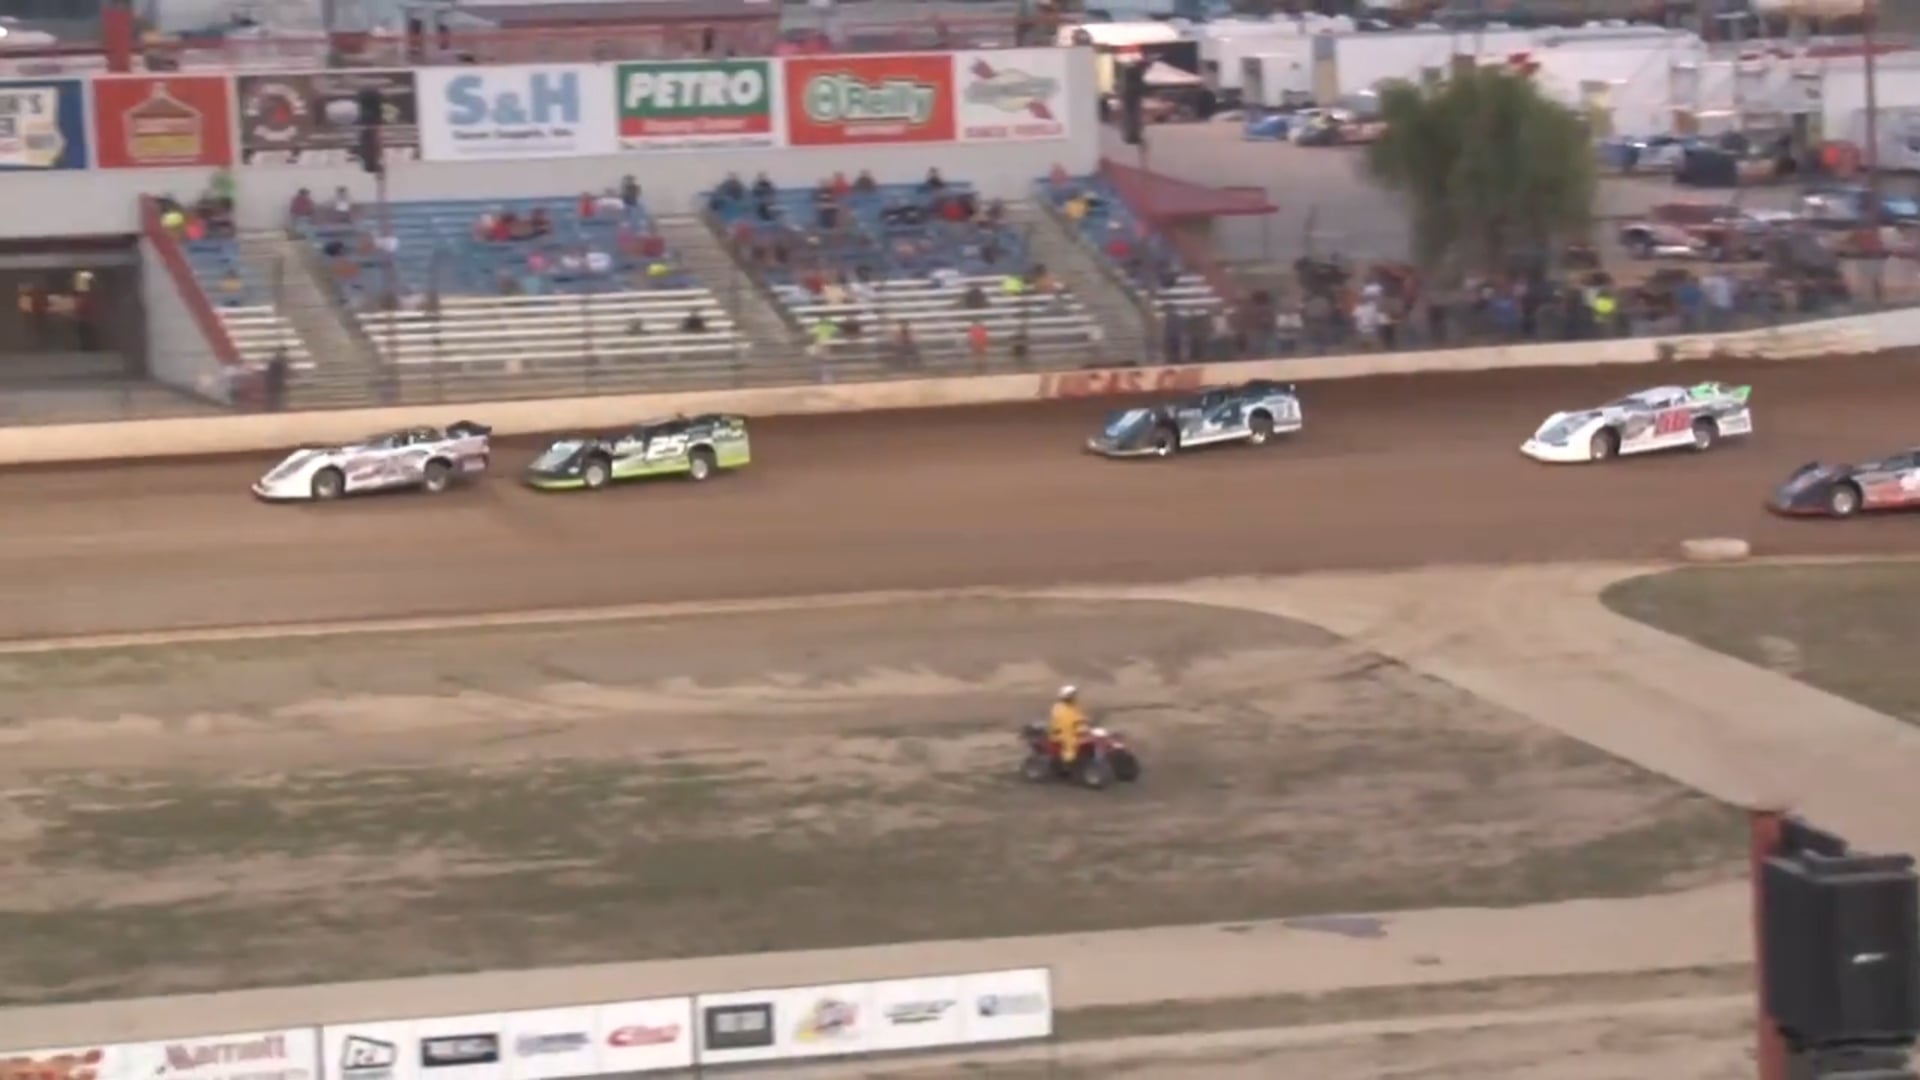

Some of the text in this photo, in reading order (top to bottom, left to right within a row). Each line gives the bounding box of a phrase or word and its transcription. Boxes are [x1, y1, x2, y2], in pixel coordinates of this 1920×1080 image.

[446, 72, 579, 125] S&H
[625, 68, 763, 109] PETRO
[804, 71, 936, 125] O'Reilly
[646, 433, 690, 460] 25
